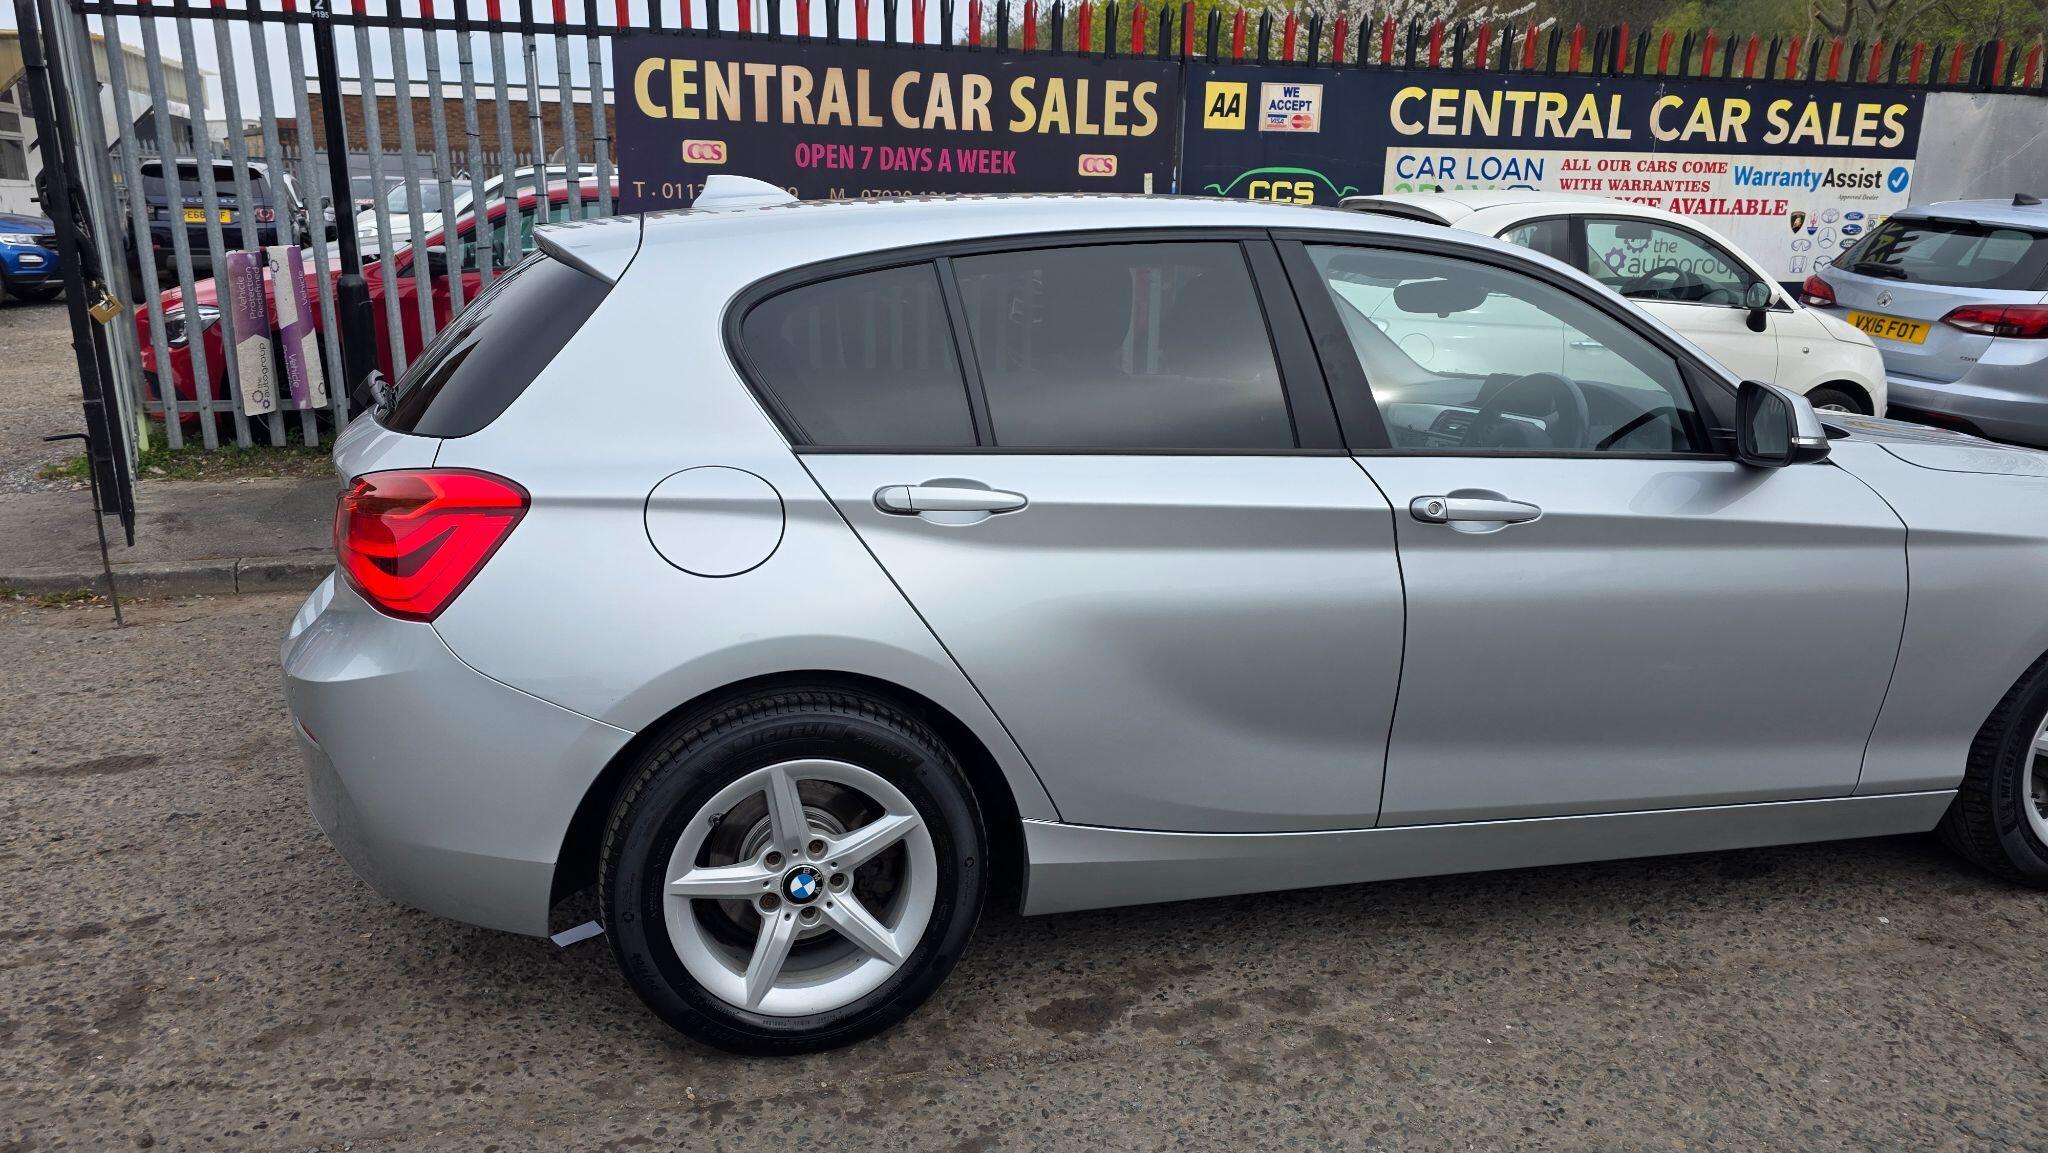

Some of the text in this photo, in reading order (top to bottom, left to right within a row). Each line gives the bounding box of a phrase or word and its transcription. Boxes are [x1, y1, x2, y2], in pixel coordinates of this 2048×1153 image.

[635, 58, 1158, 137] CENTRAL CAR SALES
[1283, 86, 1300, 98] WE
[1209, 93, 1241, 118] AA
[1269, 99, 1313, 112] ACCEPT
[1391, 86, 1909, 147] CENTRAL CAR SALES
[795, 142, 1016, 174] OPEN 7 DAYS A WEEK
[1396, 155, 1545, 181] CAR LOAN
[1561, 159, 1728, 174] ALL OUR CARS COME
[1249, 181, 1315, 205] CCS
[1560, 178, 1710, 192] WITH WARRANTIES
[1668, 198, 1788, 216] AVAILABLE
[1654, 238, 1678, 253] the
[236, 276, 248, 312] Vehicle
[246, 266, 259, 319] Protection
[252, 267, 264, 318] Redefined
[1856, 315, 1920, 339] VX16 FOT
[260, 342, 270, 398] autogroup
[288, 353, 301, 388] Vehicle
